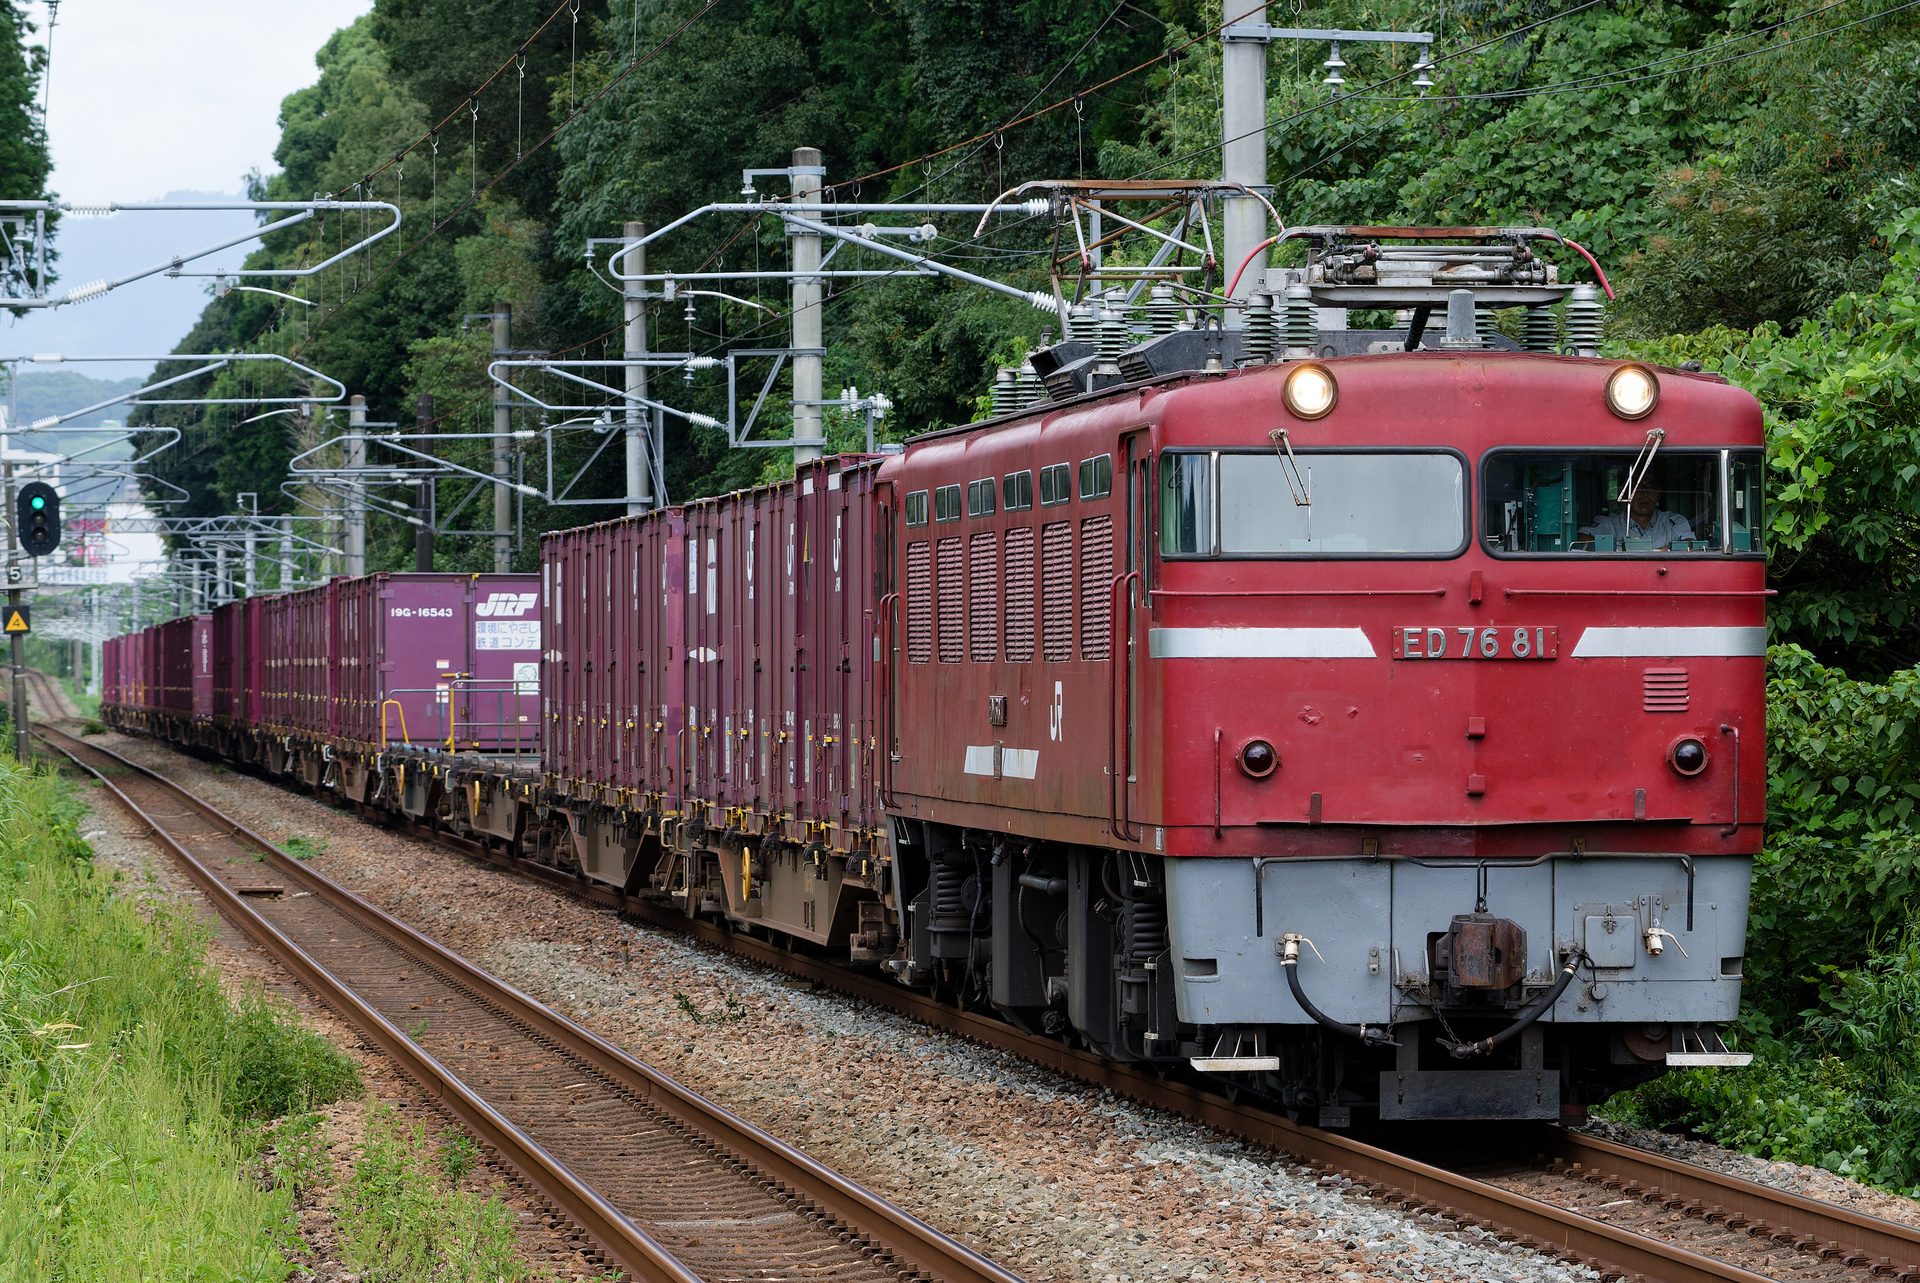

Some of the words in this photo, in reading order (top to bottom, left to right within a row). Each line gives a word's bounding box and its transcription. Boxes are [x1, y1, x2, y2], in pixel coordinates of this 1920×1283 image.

[9, 566, 22, 581] 5
[390, 607, 453, 618] 19G-16543
[476, 593, 538, 616] JRF
[12, 618, 21, 627] 4
[1403, 628, 1447, 658] ED
[1457, 628, 1499, 658] 76
[1512, 628, 1544, 658] 81
[1050, 680, 1063, 742] JR
